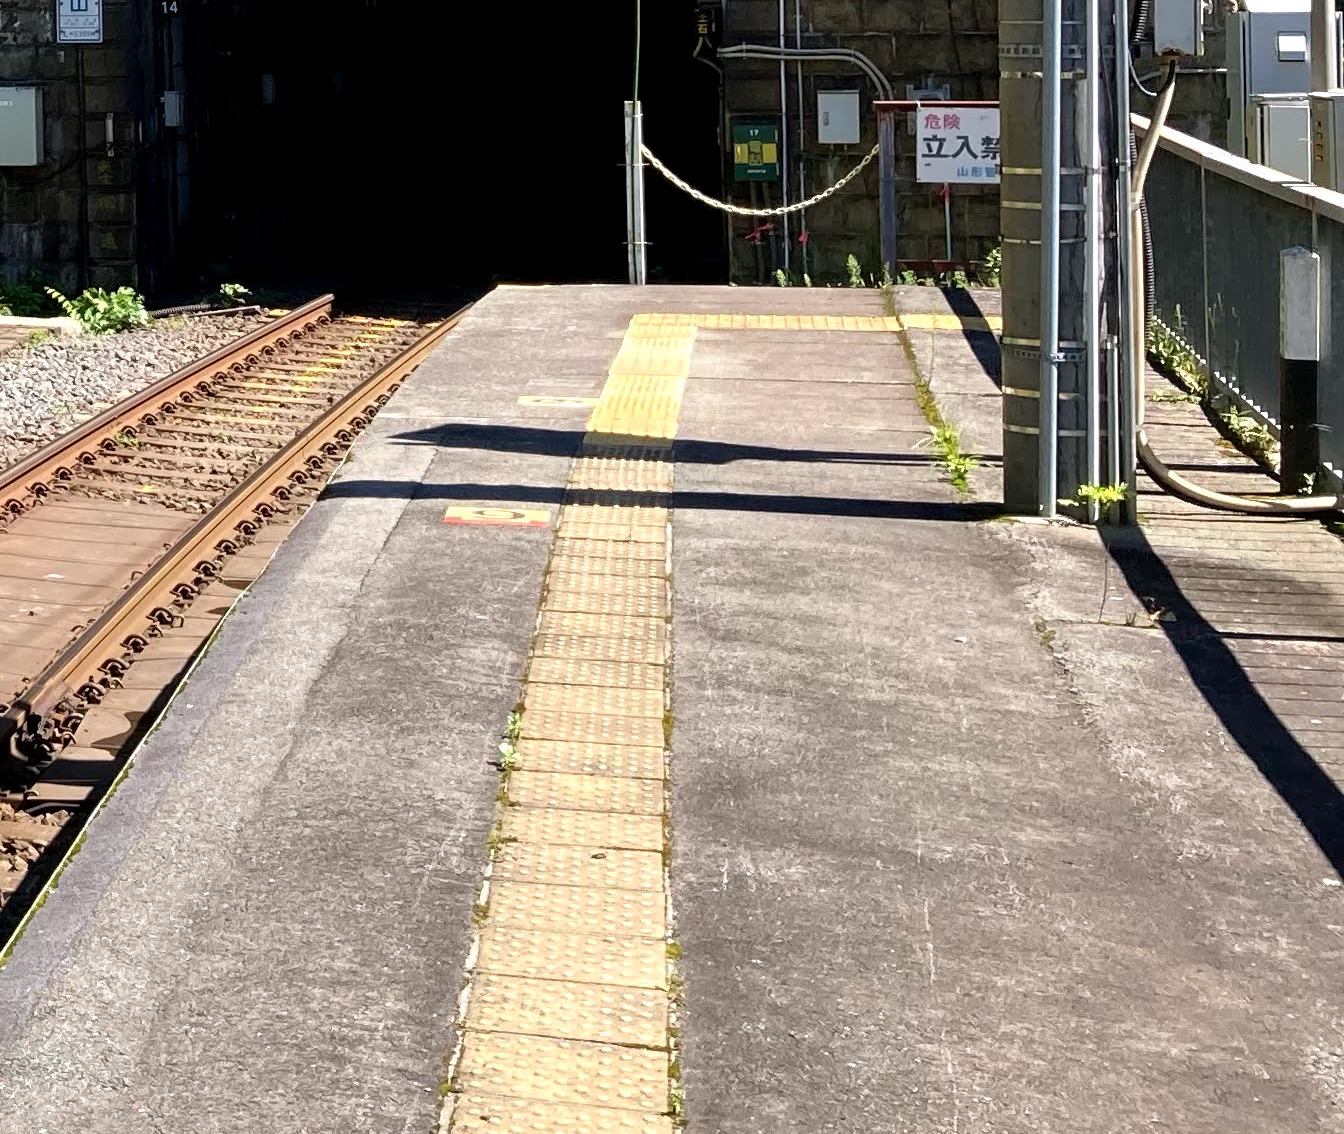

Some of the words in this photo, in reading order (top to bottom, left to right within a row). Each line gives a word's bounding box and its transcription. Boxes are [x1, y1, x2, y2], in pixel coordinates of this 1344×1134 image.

[161, 1, 178, 14] 14
[924, 113, 961, 130] 危険
[921, 134, 1000, 160] 立入禁
